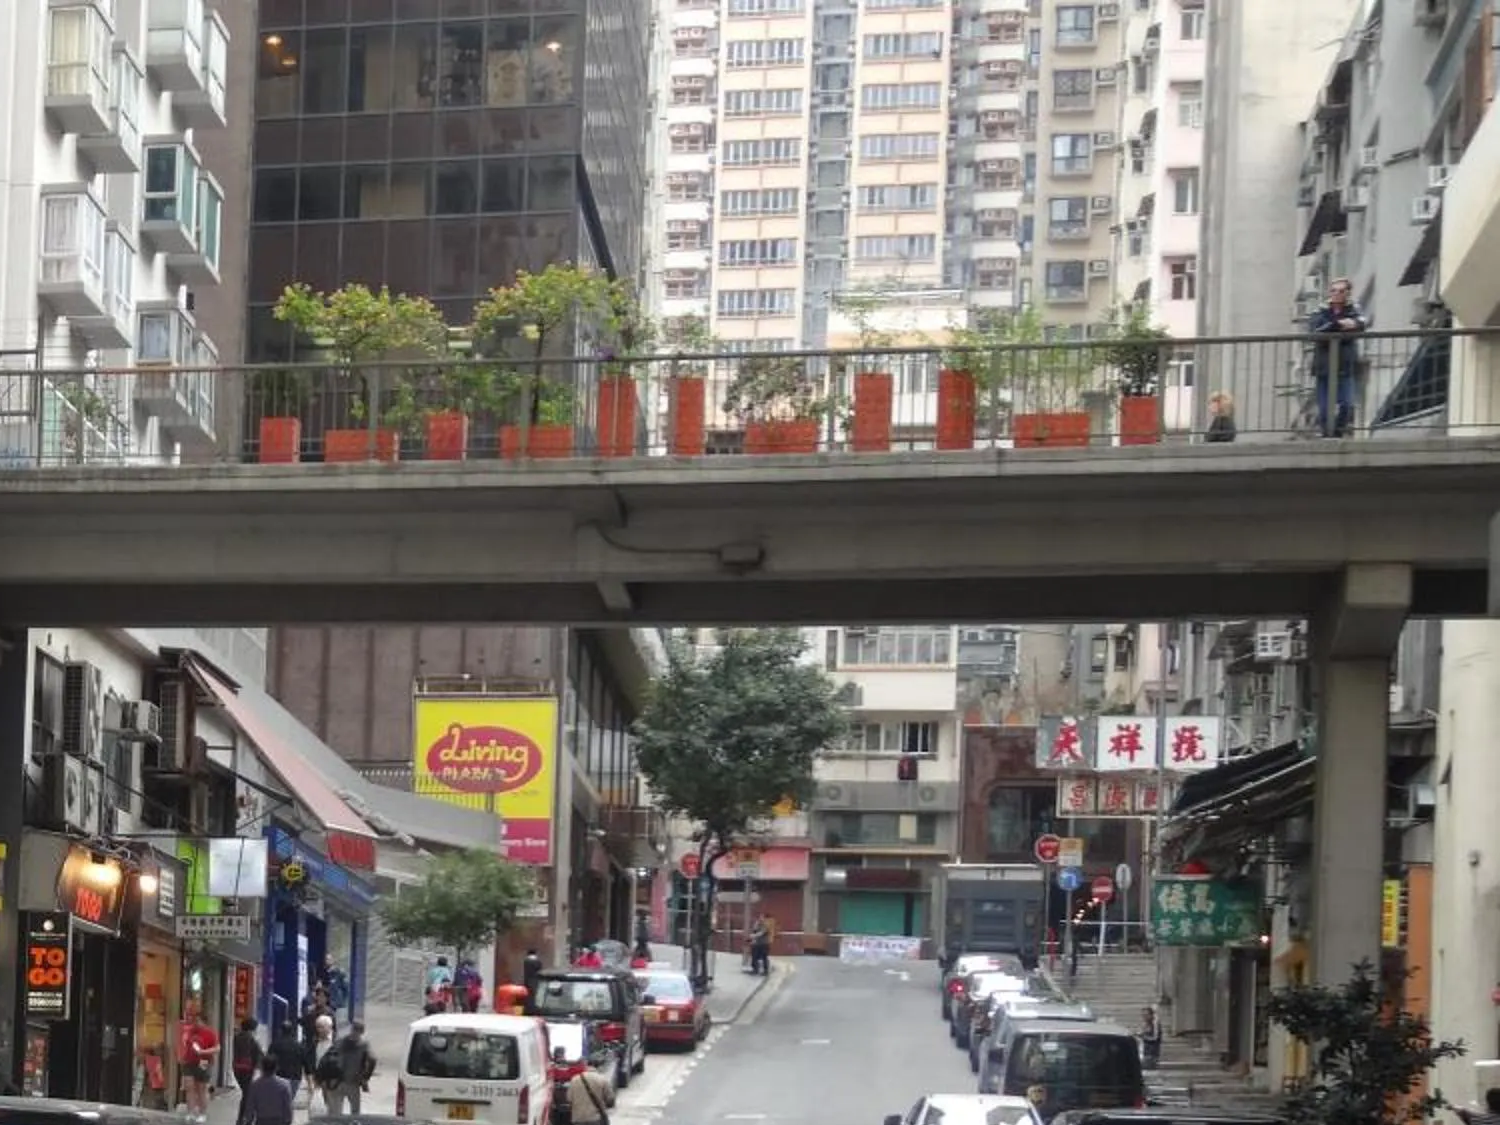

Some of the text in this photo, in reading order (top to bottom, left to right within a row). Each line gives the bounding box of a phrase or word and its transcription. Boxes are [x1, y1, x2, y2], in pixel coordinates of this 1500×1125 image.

[438, 725, 531, 784] Living
[28, 946, 66, 967] TO
[28, 967, 65, 987] GO
